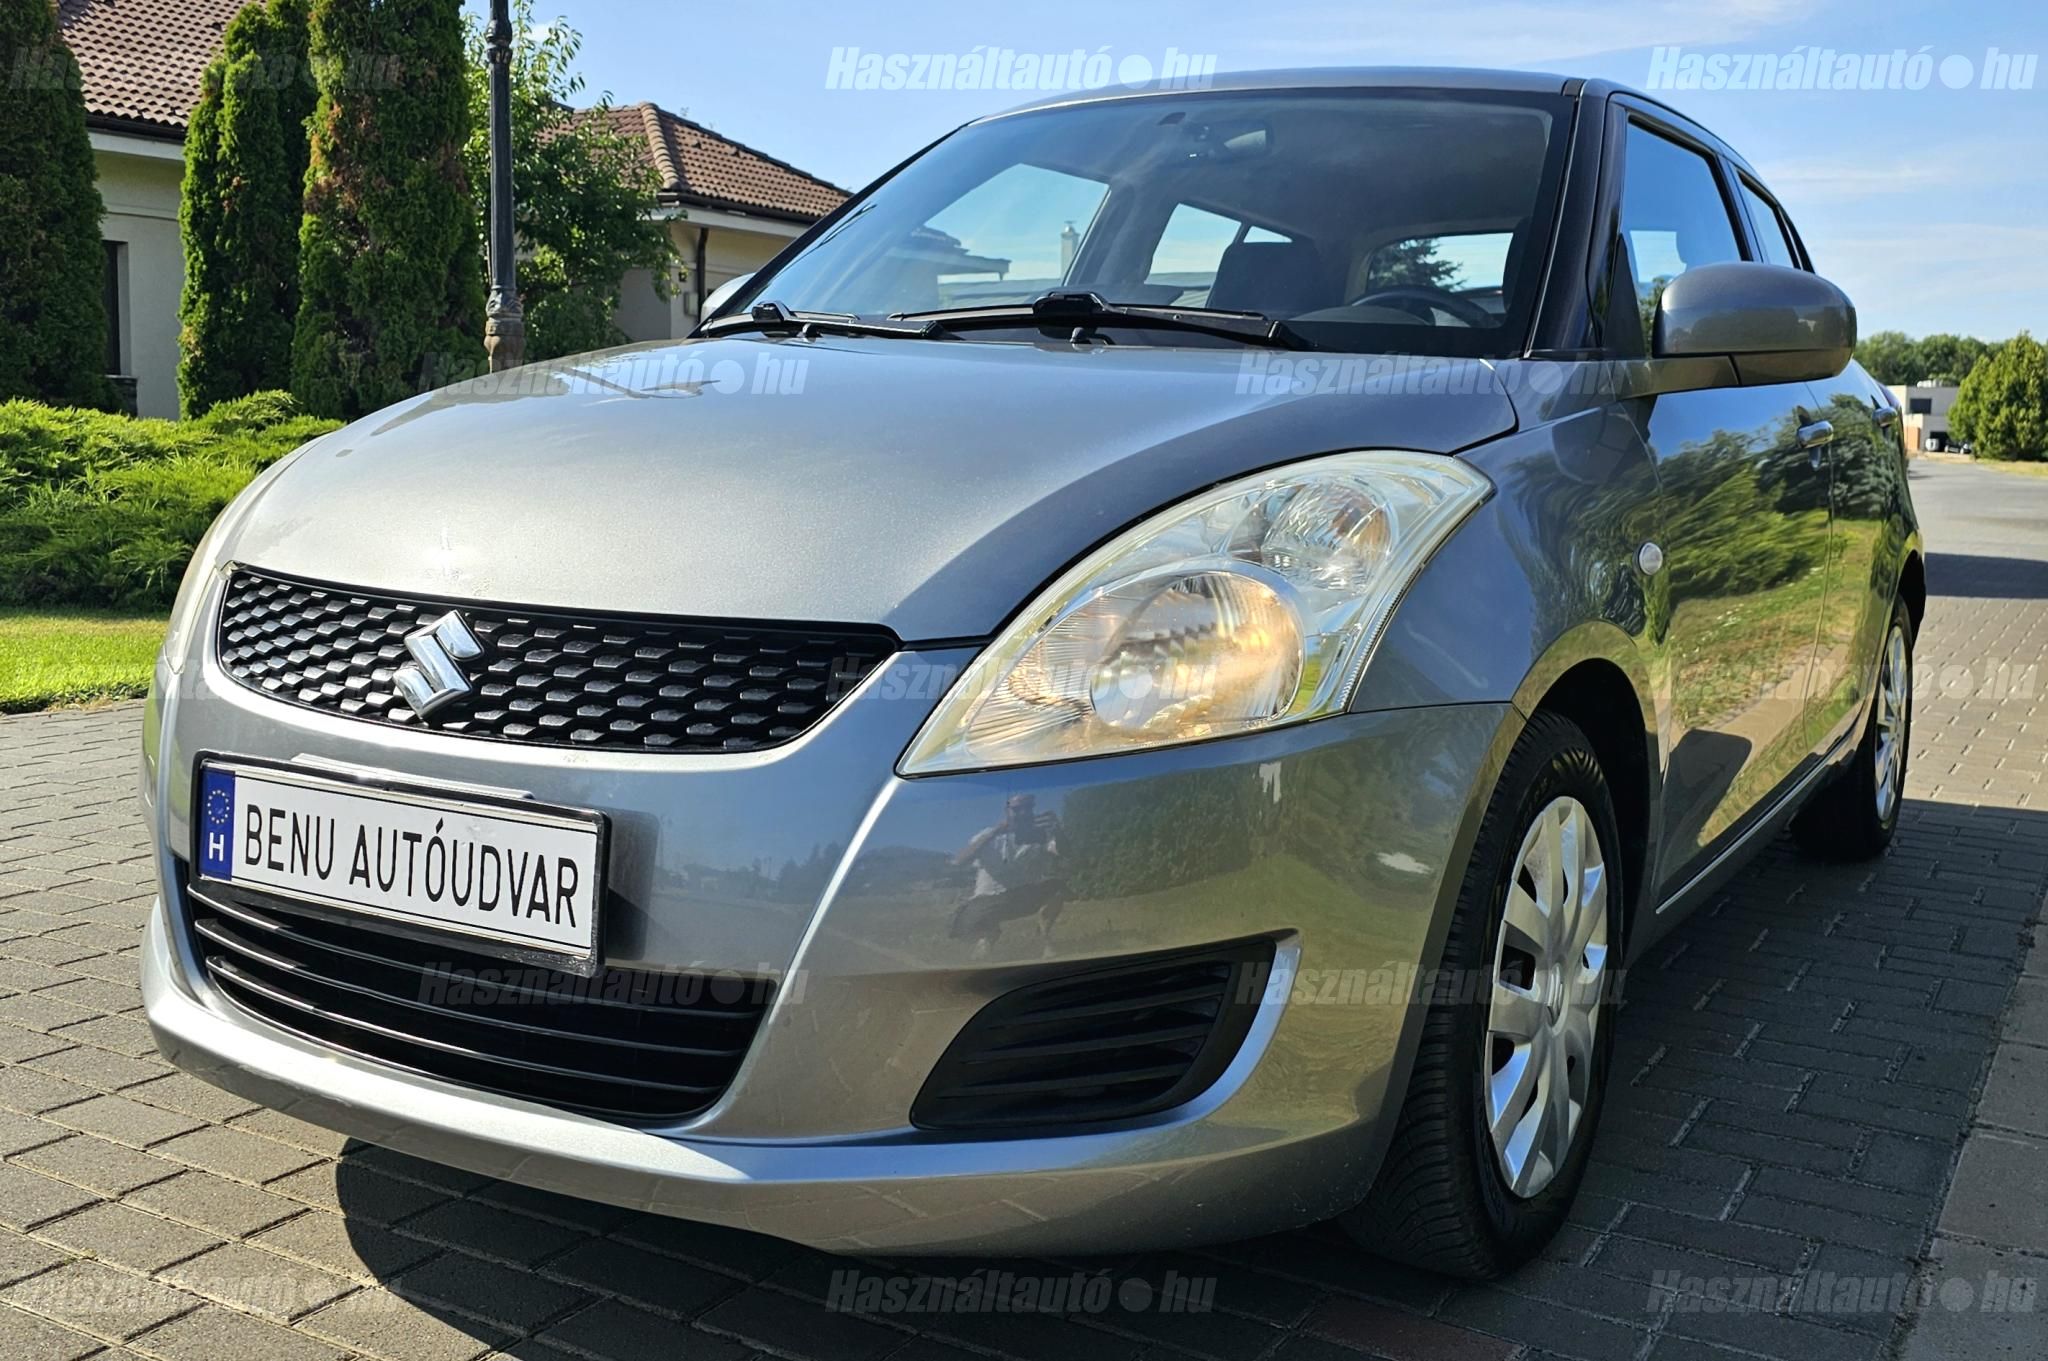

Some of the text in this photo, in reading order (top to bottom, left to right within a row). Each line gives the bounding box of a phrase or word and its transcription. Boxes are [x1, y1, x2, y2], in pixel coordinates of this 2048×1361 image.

[208, 831, 225, 862] H
[244, 803, 579, 928] BENU AUTÓUDVAR
